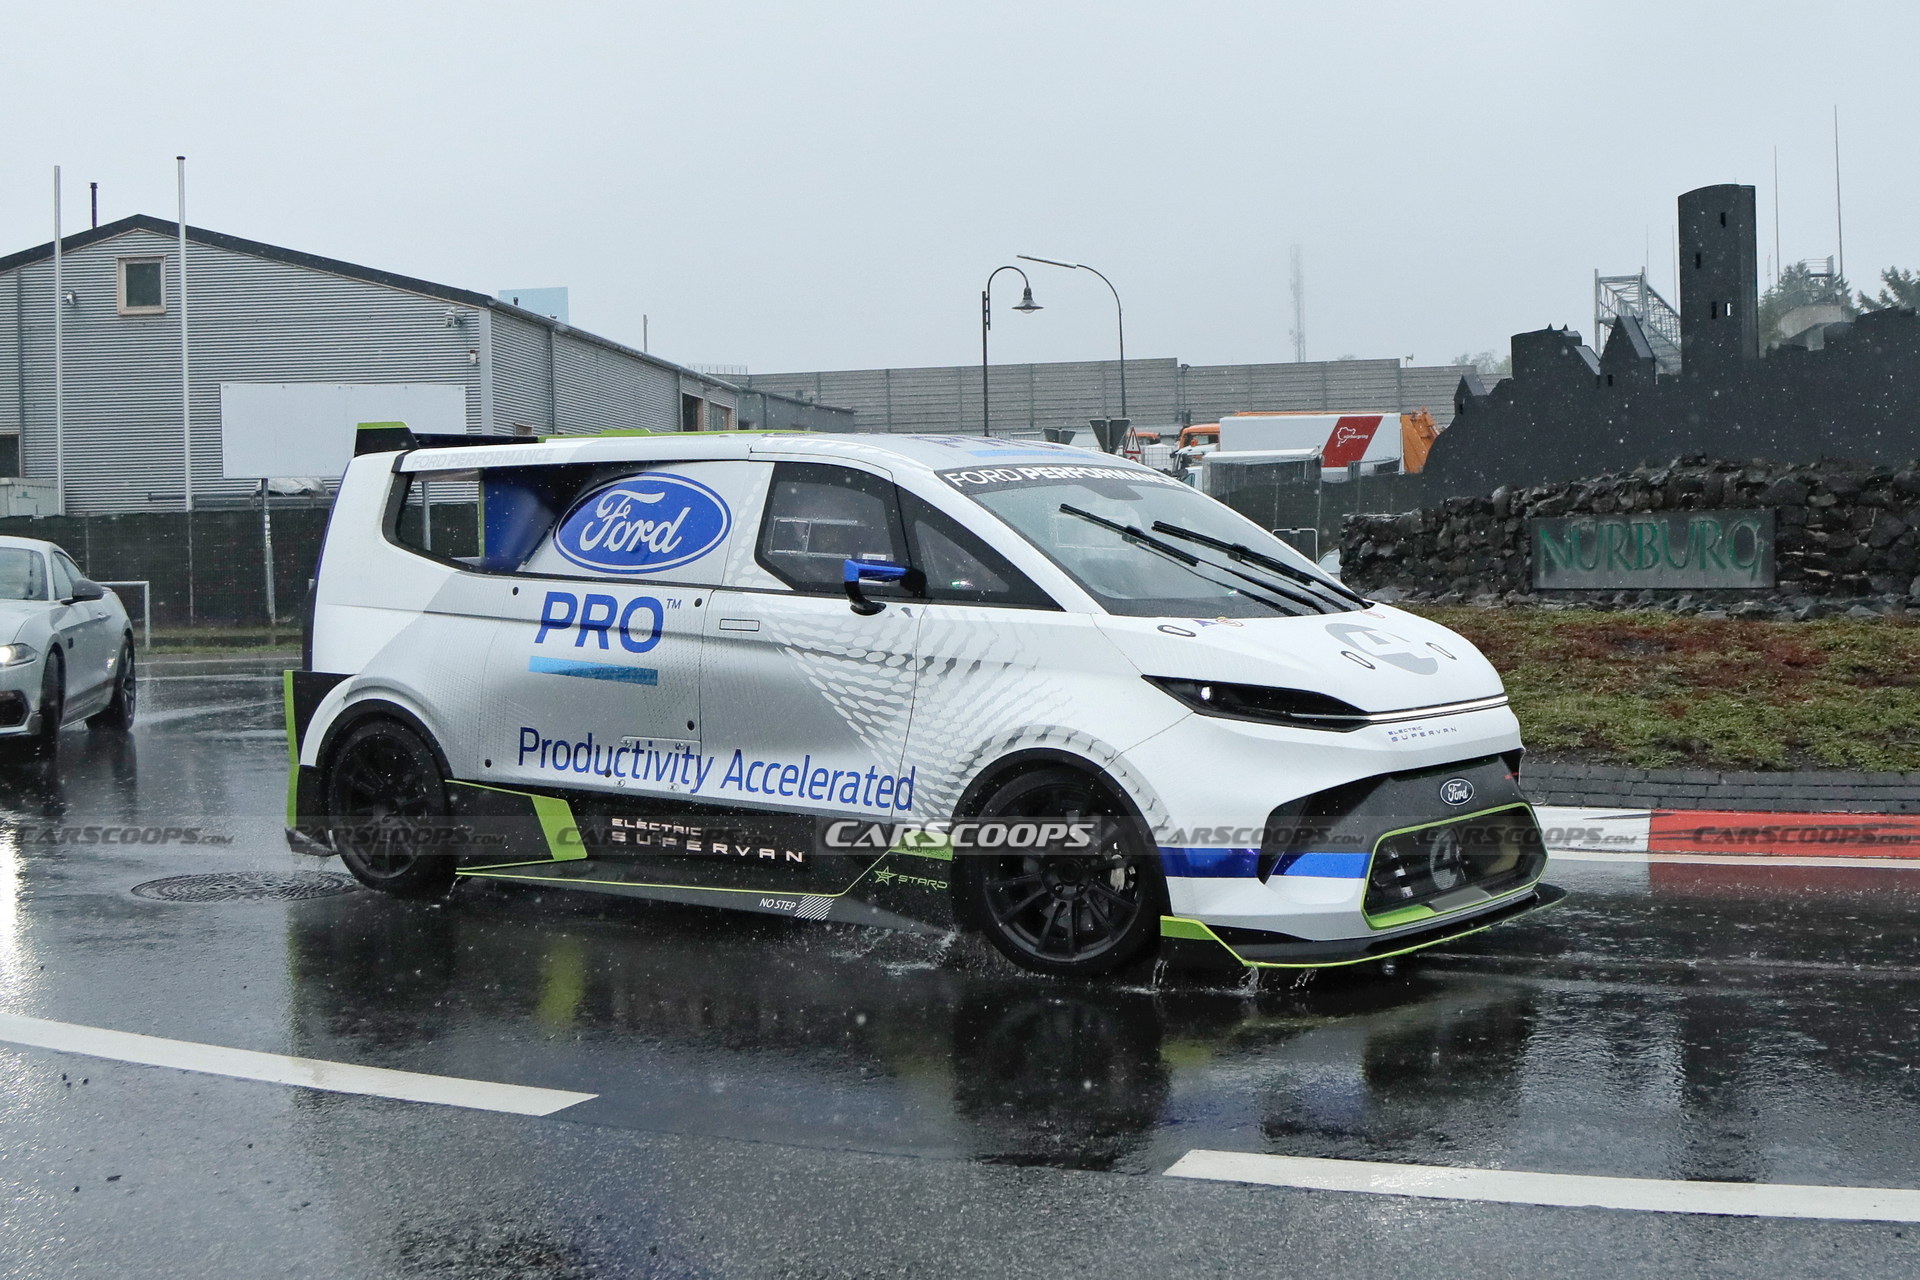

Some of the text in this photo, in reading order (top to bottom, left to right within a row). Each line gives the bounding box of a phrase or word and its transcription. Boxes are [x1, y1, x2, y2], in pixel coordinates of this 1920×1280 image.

[412, 449, 554, 468] FORD PERFORMANCE
[944, 468, 1022, 487] FORD
[580, 490, 691, 554] Ford
[534, 591, 664, 653] PRO
[1388, 726, 1423, 735] ELECTRIC
[1391, 727, 1458, 742] SUPERVAN
[518, 727, 915, 811] Productivity Accelerated
[1448, 782, 1469, 802] Ford
[612, 818, 702, 836] ELECTRIC
[611, 831, 804, 862] SUPERVAN
[898, 875, 948, 890] STARD
[759, 898, 797, 911] NO STEP
